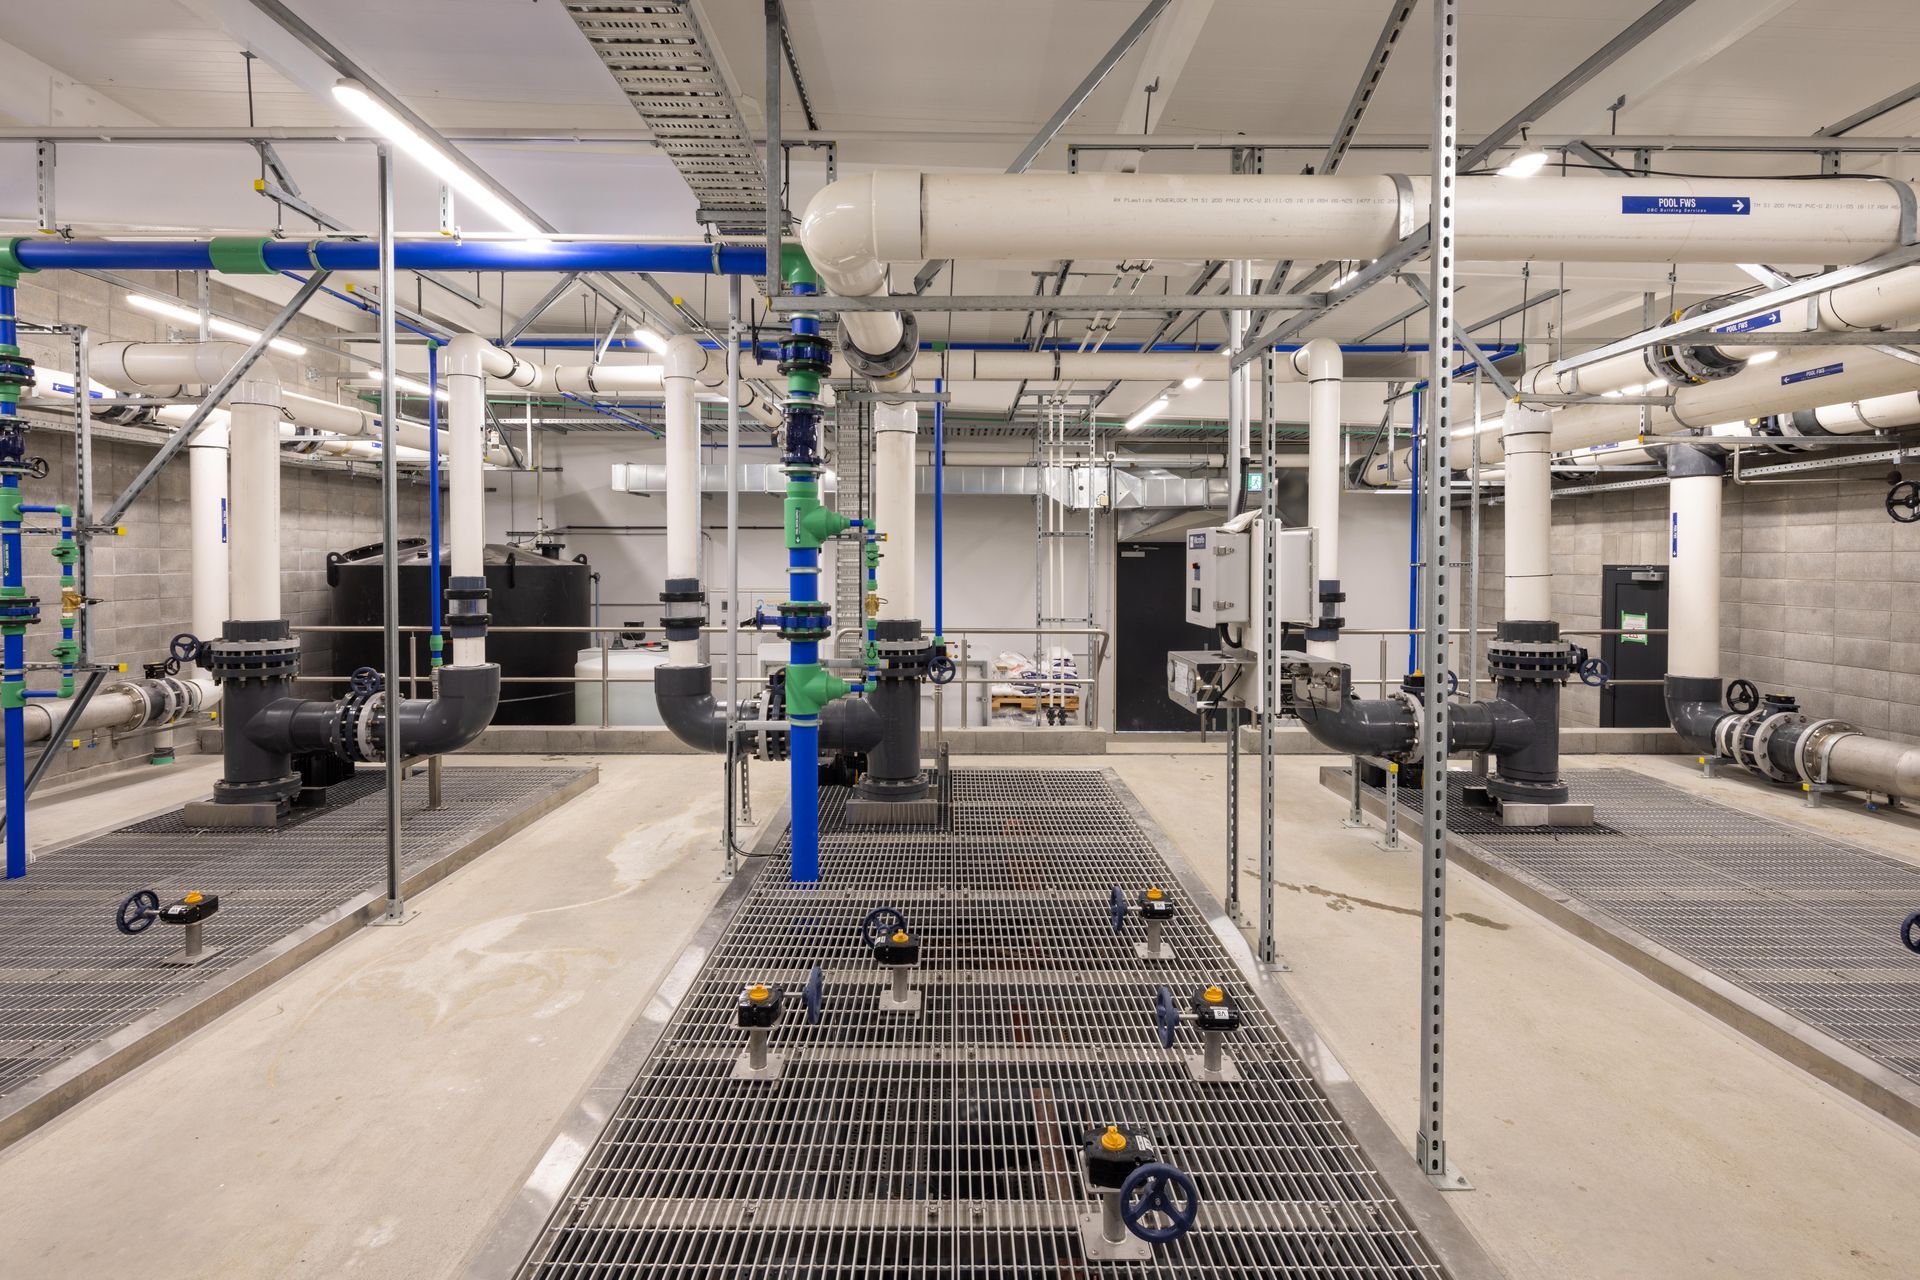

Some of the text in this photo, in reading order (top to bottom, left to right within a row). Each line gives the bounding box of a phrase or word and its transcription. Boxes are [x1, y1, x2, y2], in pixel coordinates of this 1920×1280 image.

[1658, 198, 1696, 208] POOL FWS
[1726, 325, 1737, 333] POOL
[1738, 321, 1748, 329] FWS
[1805, 369, 1816, 377] POOL
[1816, 367, 1825, 375] FWS
